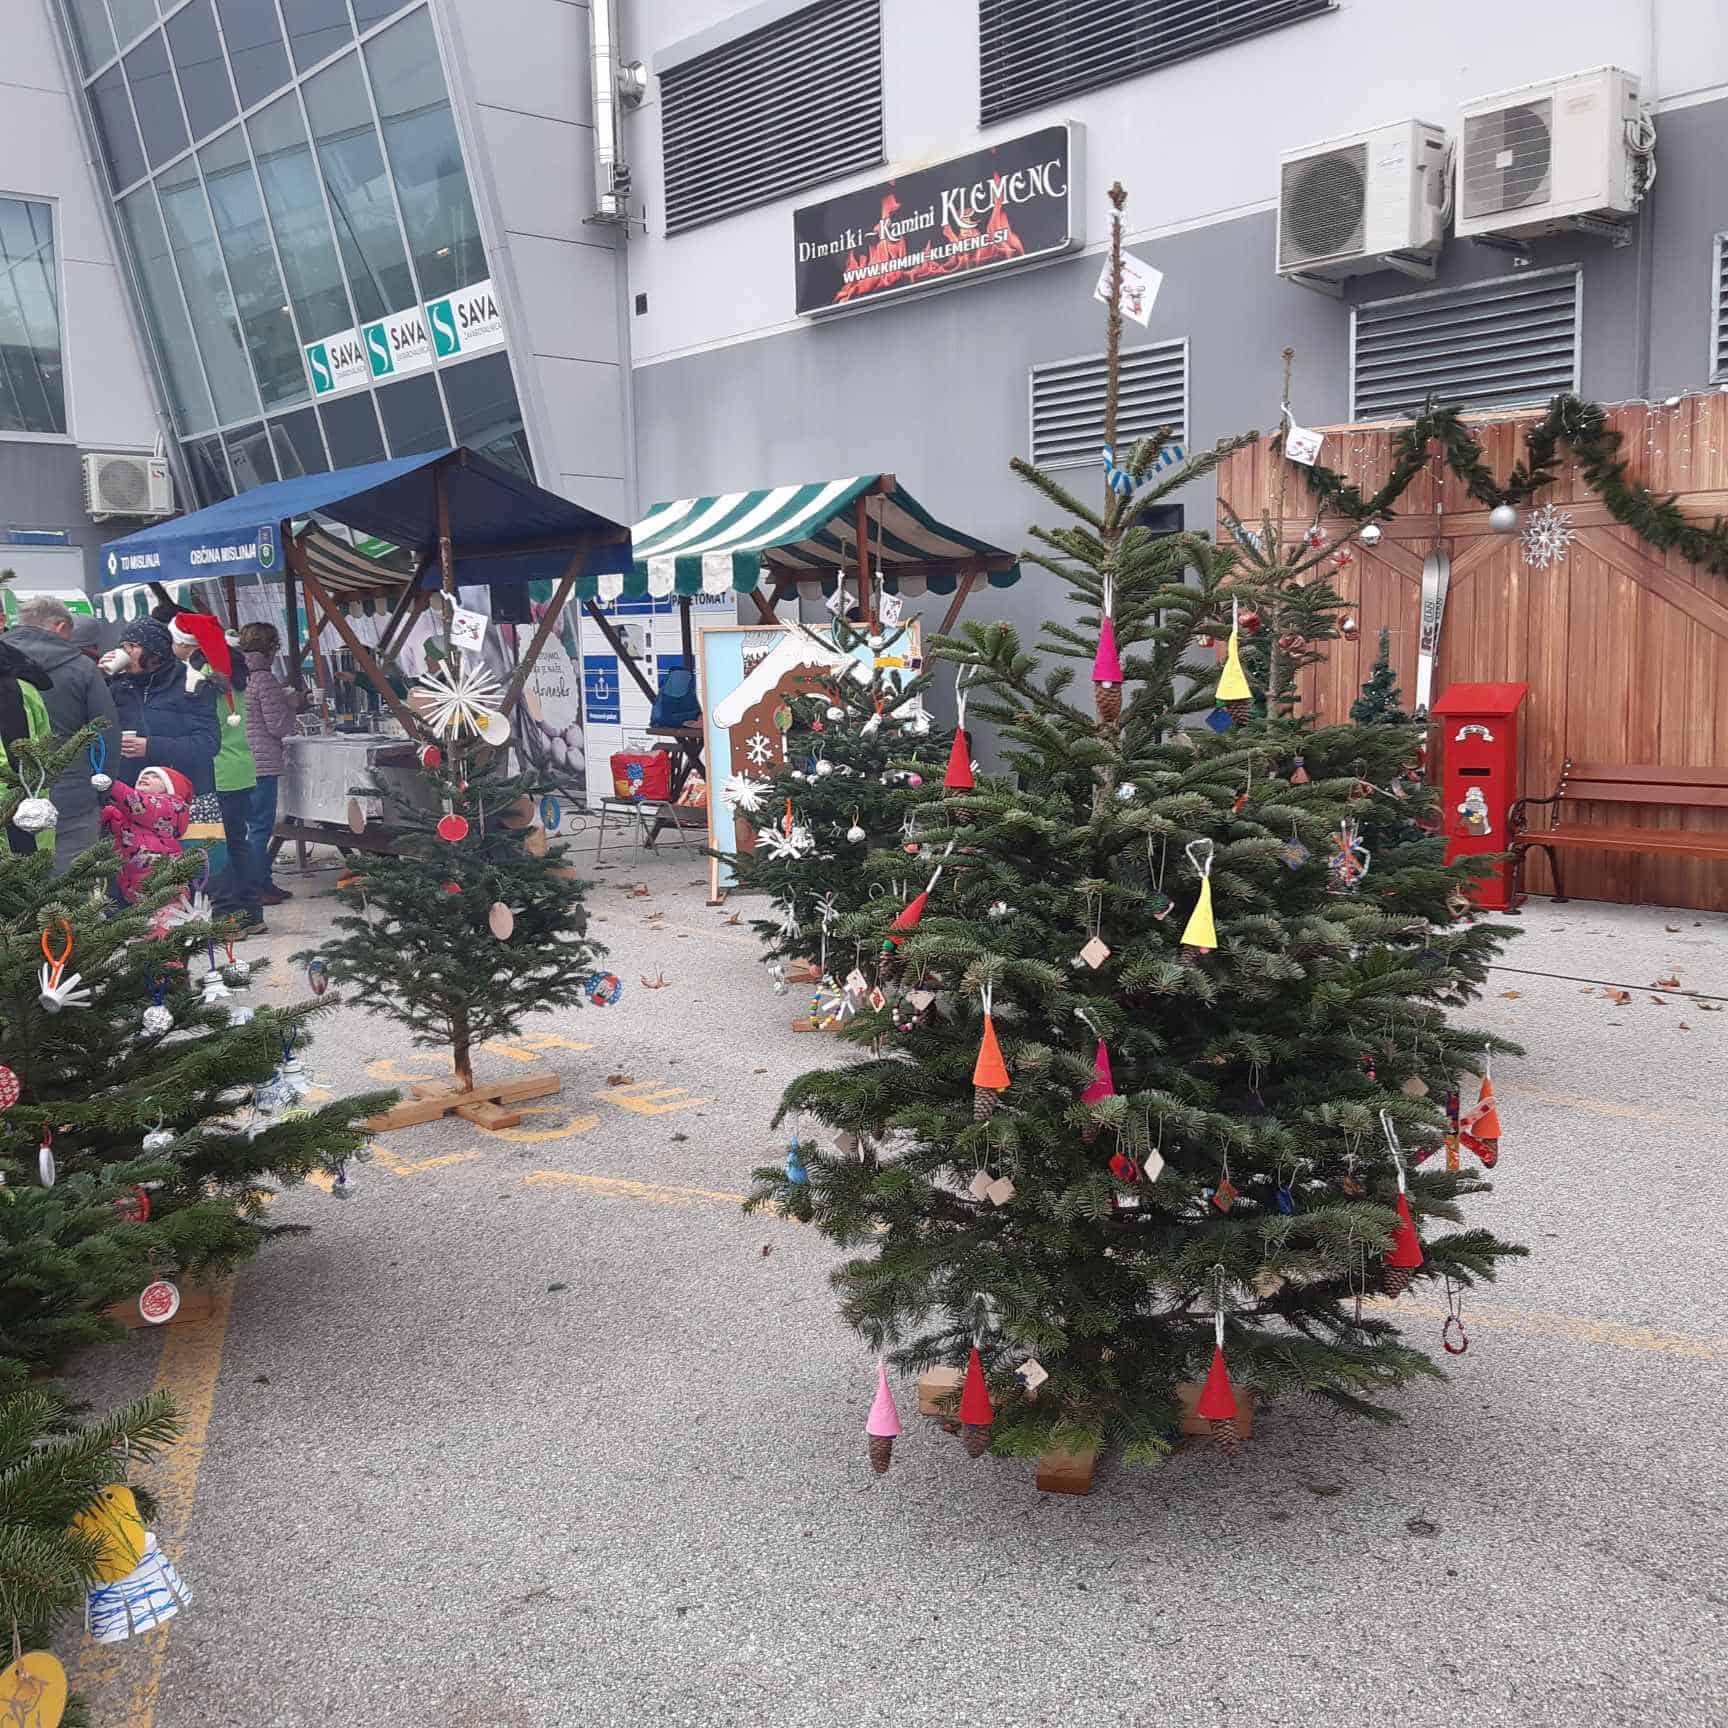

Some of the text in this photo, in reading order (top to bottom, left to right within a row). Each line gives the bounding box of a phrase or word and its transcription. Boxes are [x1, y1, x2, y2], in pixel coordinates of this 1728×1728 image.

[940, 158, 1068, 229] KLEMENC
[843, 228, 1009, 283] WWW.KAMINI-KLEMENC.SI
[457, 294, 499, 328] SAVA
[390, 320, 428, 350] SAVA
[331, 342, 364, 369] SAVA
